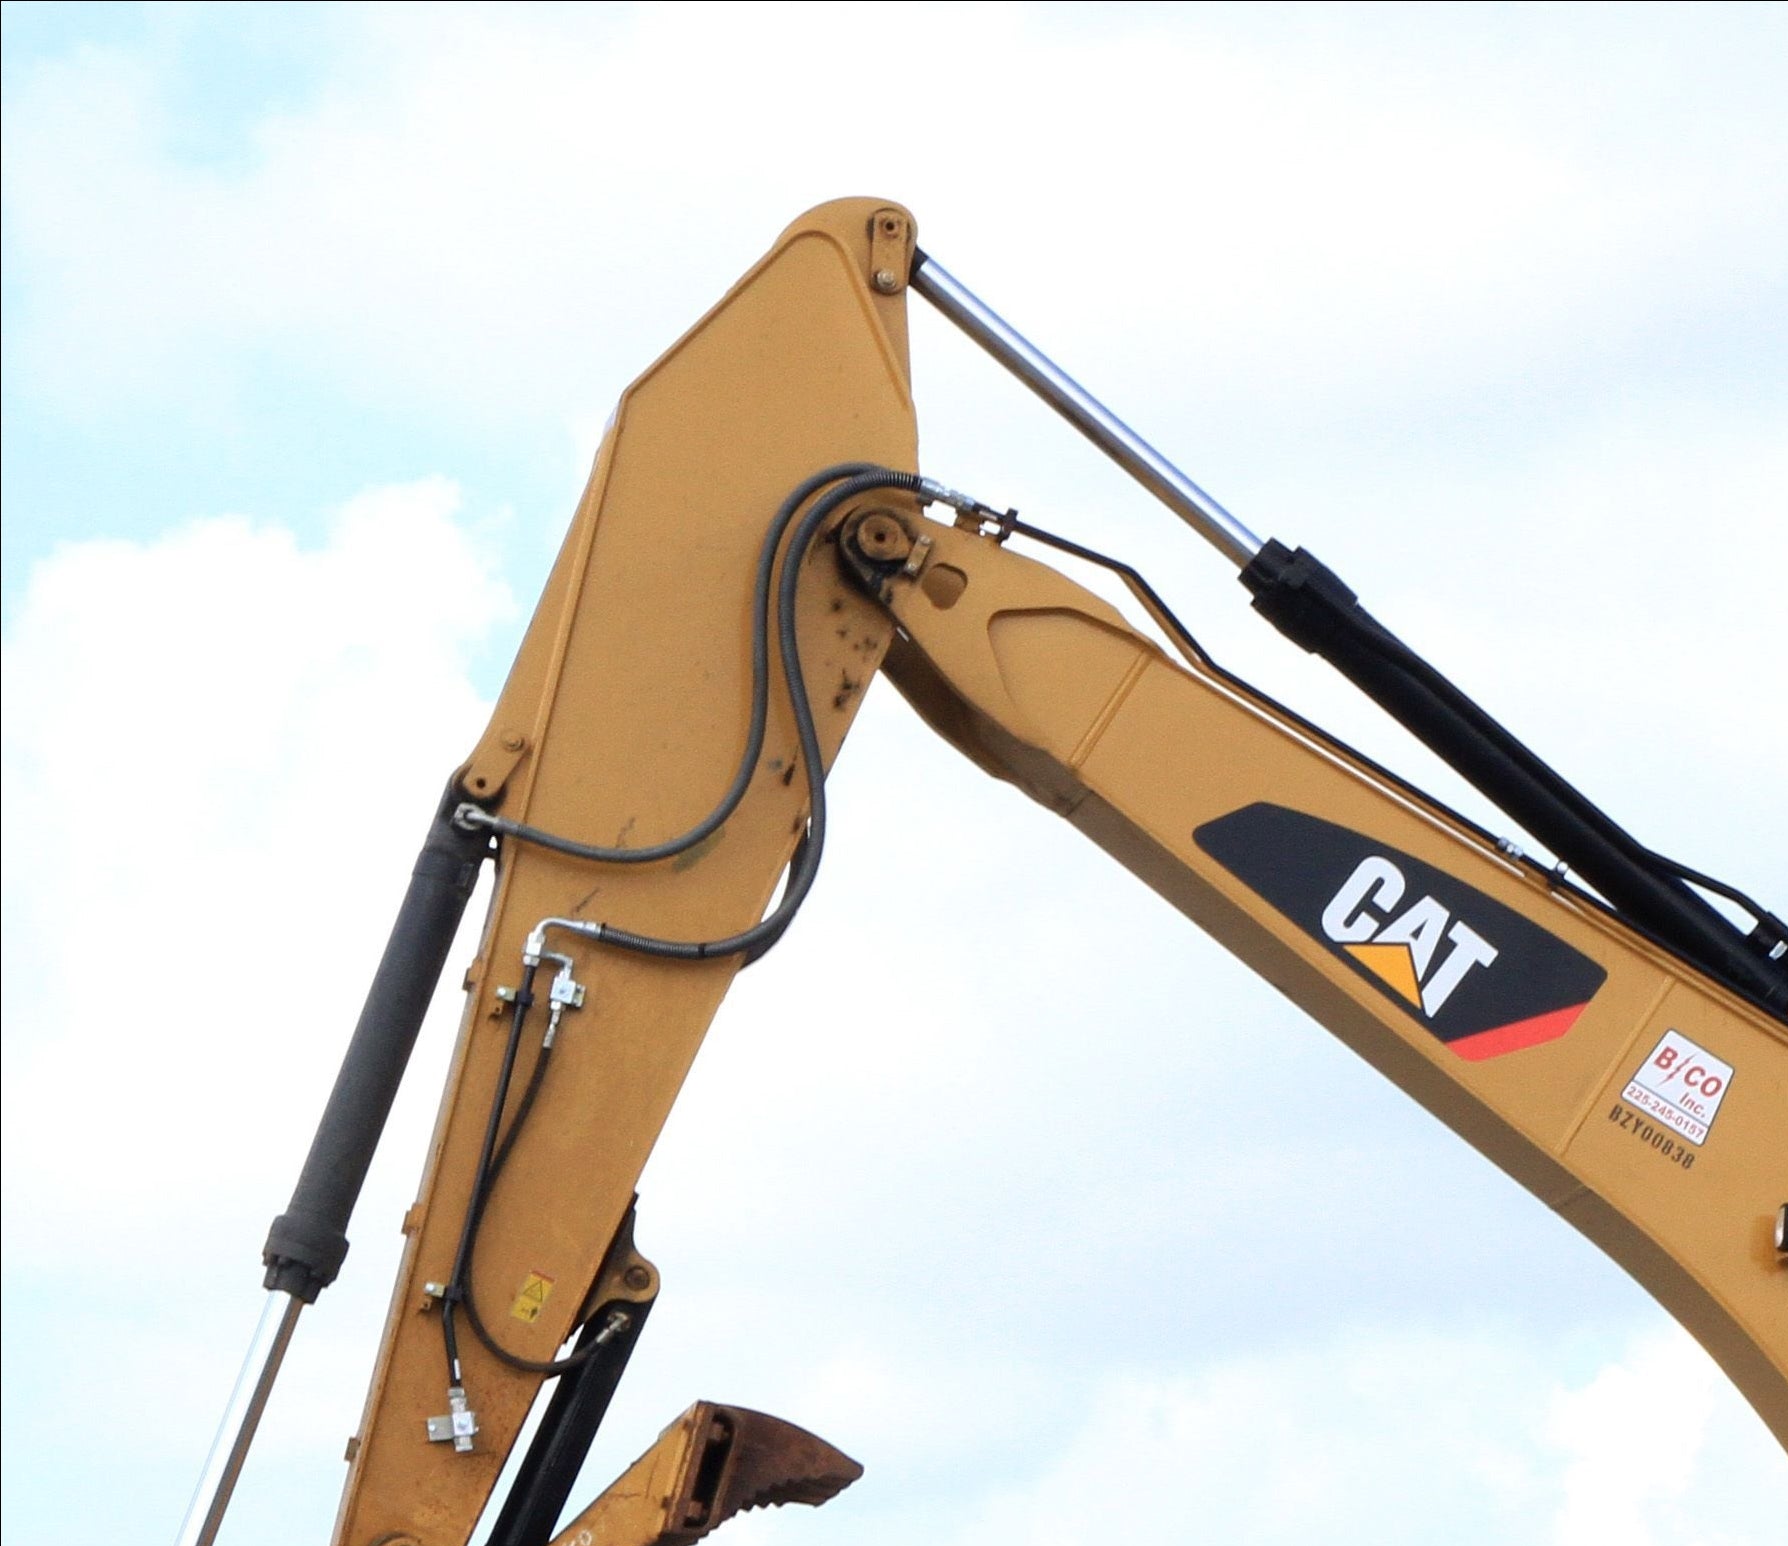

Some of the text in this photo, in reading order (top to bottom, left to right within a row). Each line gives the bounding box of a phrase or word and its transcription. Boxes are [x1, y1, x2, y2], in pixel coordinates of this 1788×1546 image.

[1321, 855, 1500, 1018] CAT
[1626, 1085, 1705, 1139] 225-245-0157
[1679, 1091, 1706, 1119] Inc.
[1608, 1103, 1696, 1170] BZY00838
